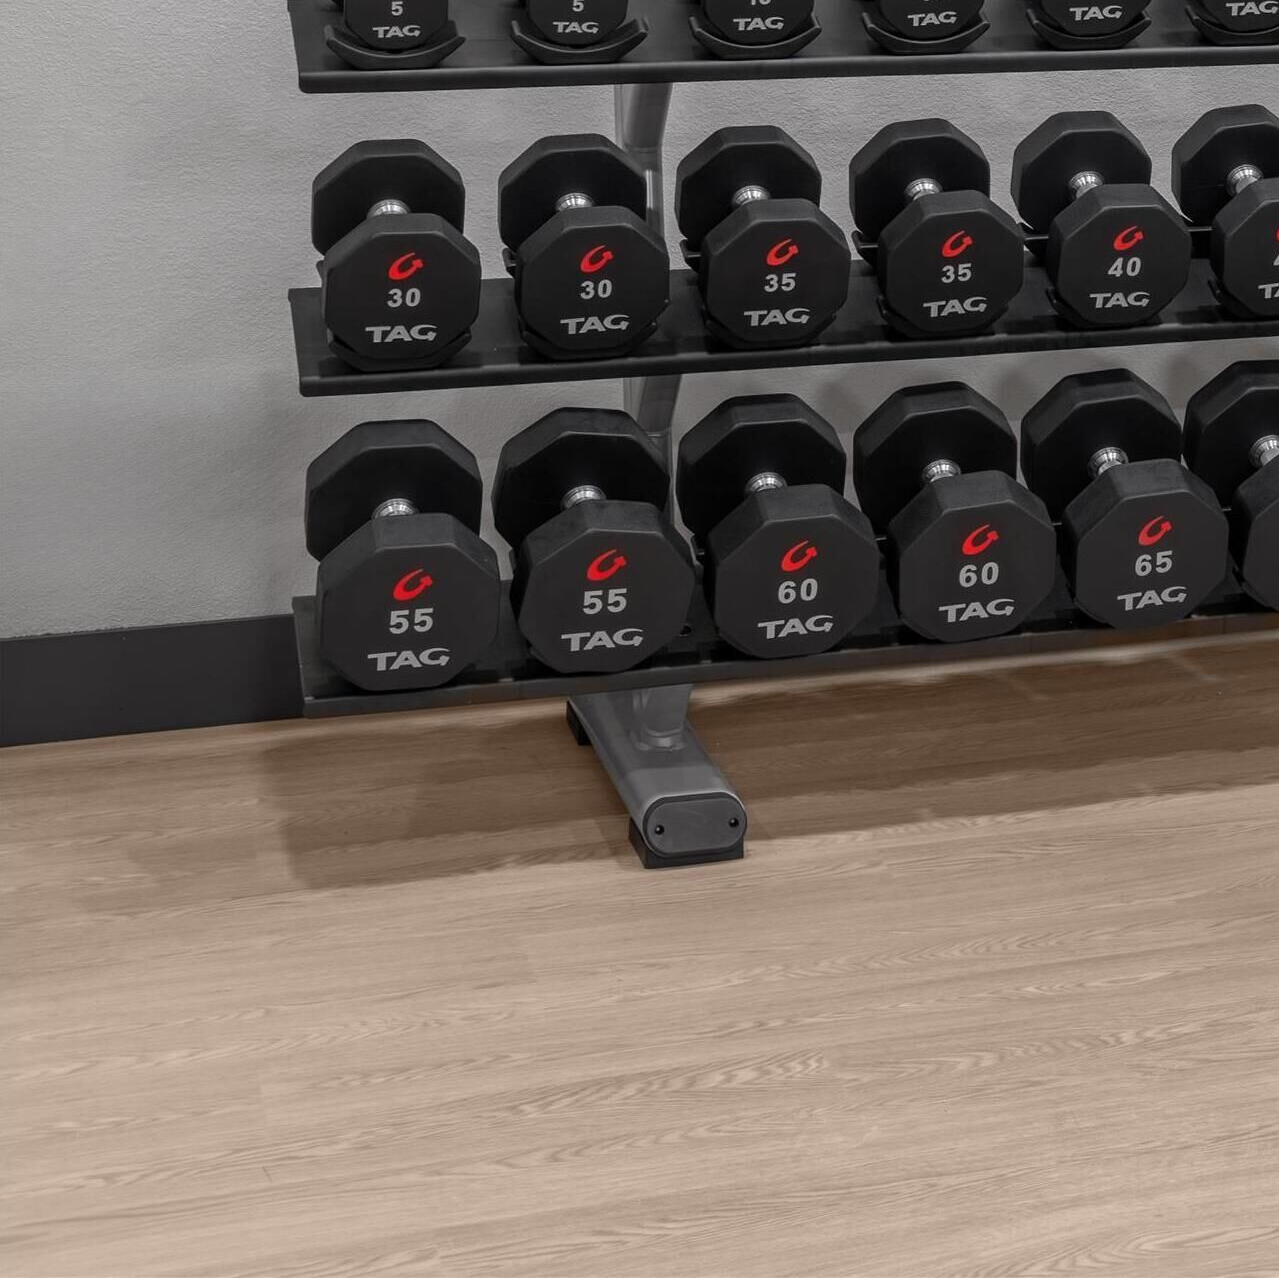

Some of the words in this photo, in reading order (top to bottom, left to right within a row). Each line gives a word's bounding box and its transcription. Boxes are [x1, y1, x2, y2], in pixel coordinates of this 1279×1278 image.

[391, 0, 404, 17] 5
[906, 10, 957, 27] TAG
[1069, 4, 1123, 21] TAG
[1225, 0, 1279, 17] TAG
[372, 24, 421, 39] TAG
[552, 21, 599, 34] TAG
[732, 16, 785, 31] TAG
[941, 262, 972, 284] 35
[1107, 256, 1142, 278] 40
[580, 279, 613, 300] 30
[764, 272, 797, 293] 35
[386, 287, 421, 308] 30
[922, 296, 988, 318] TAG
[1089, 291, 1150, 309] TAG
[559, 314, 630, 335] TAG
[743, 307, 810, 327] TAG
[364, 324, 437, 343] TAG
[1134, 549, 1173, 577] 65
[958, 561, 1000, 588] 60
[582, 587, 628, 615] 55
[777, 577, 819, 604] 60
[1116, 585, 1188, 611] TAG
[388, 607, 434, 635] 55
[938, 598, 1015, 623] TAG
[757, 614, 834, 640] TAG
[560, 627, 644, 652] TAG
[366, 647, 451, 672] TAG
